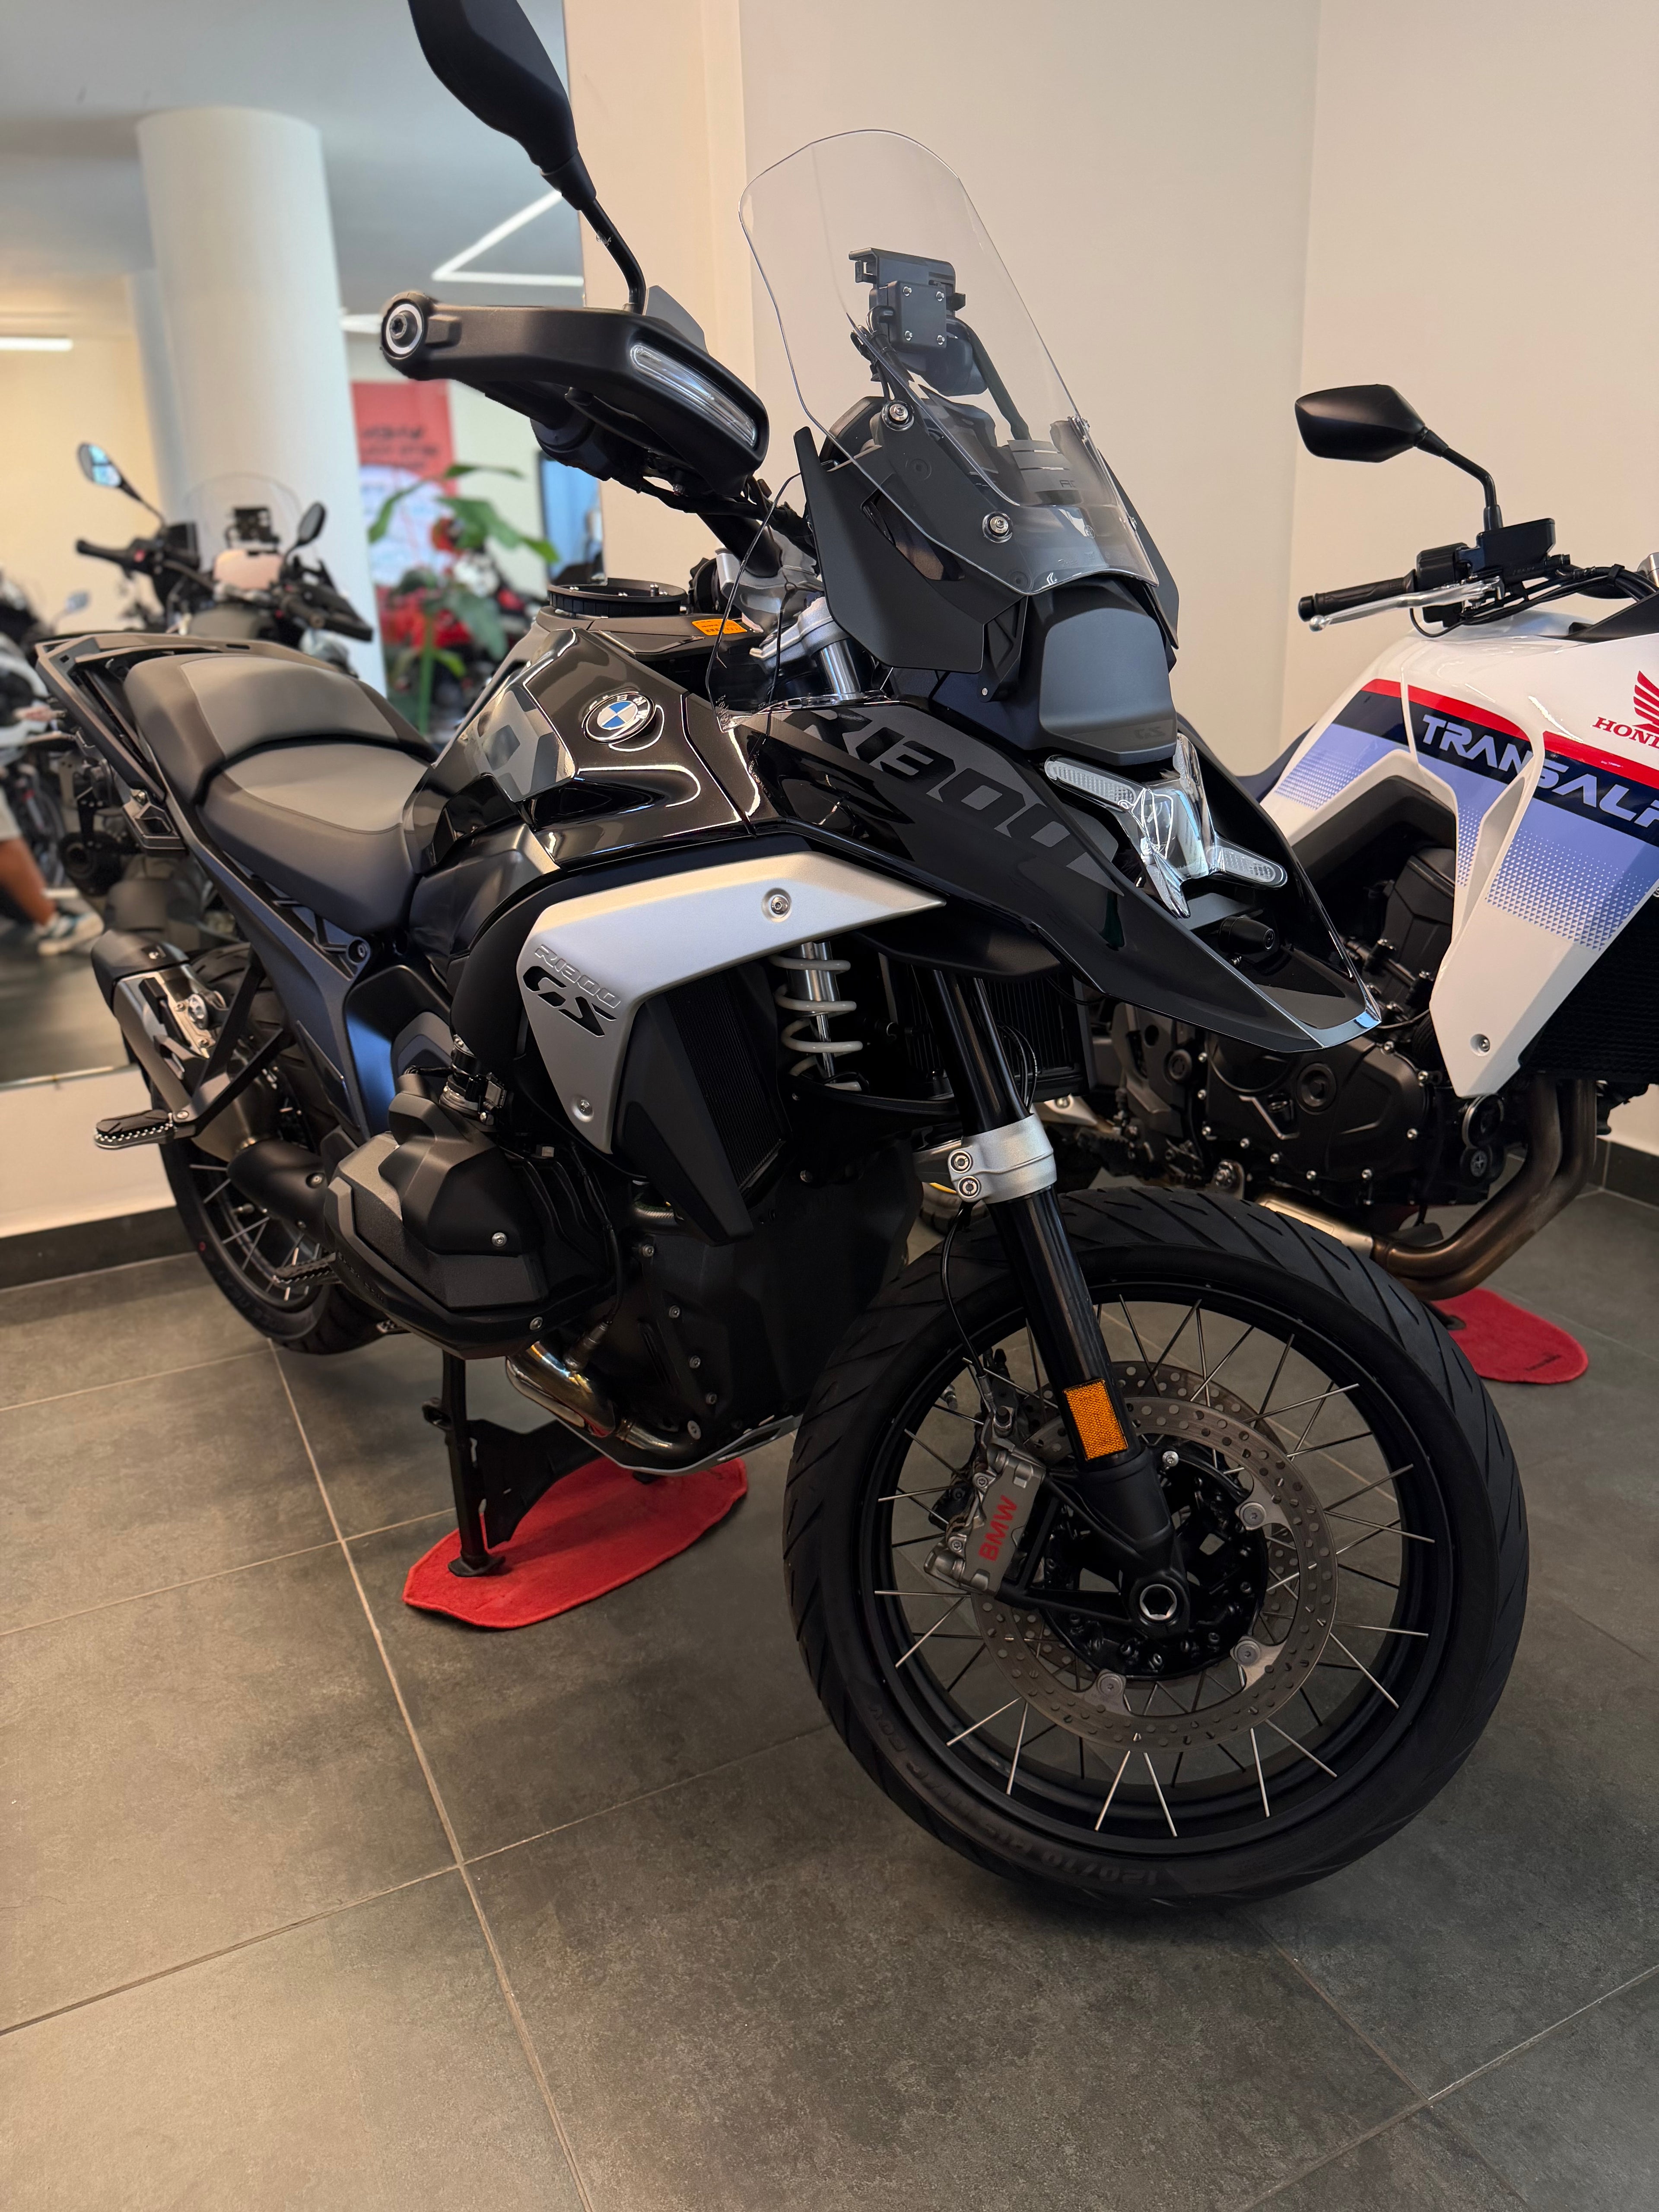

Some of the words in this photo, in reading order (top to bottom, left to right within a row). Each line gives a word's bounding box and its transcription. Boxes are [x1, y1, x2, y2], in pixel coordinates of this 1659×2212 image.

[523, 966, 617, 1037] GS
[534, 944, 621, 1009] R1300
[978, 1494, 1018, 1561] BMW
